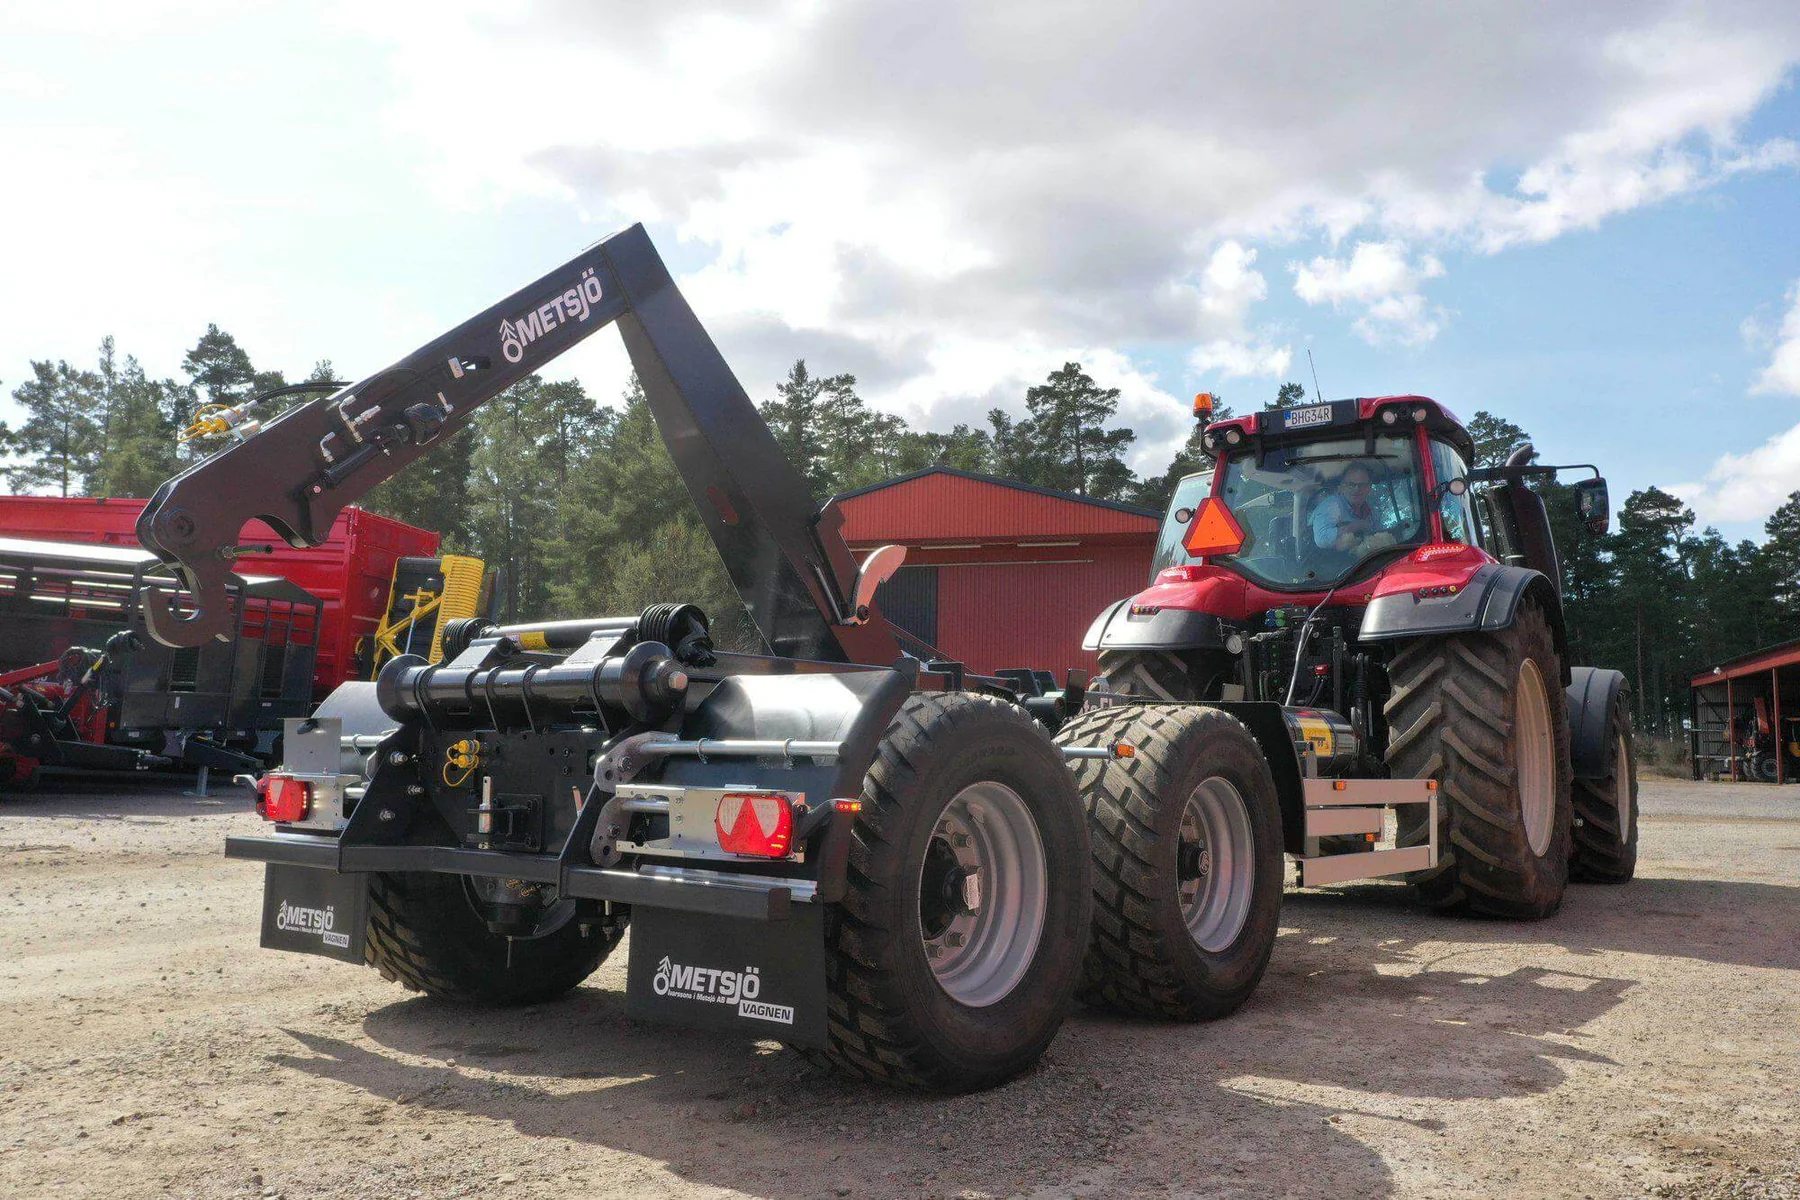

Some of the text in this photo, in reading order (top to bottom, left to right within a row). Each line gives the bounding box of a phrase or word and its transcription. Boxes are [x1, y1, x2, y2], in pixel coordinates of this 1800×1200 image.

[515, 267, 603, 347] METSJÖ
[1291, 408, 1330, 425] BHG34R
[286, 905, 334, 935] METSJÖ
[324, 932, 347, 945] VAGNEN
[670, 964, 760, 1005] METSJÖ
[743, 1002, 791, 1020] VAGNEN
